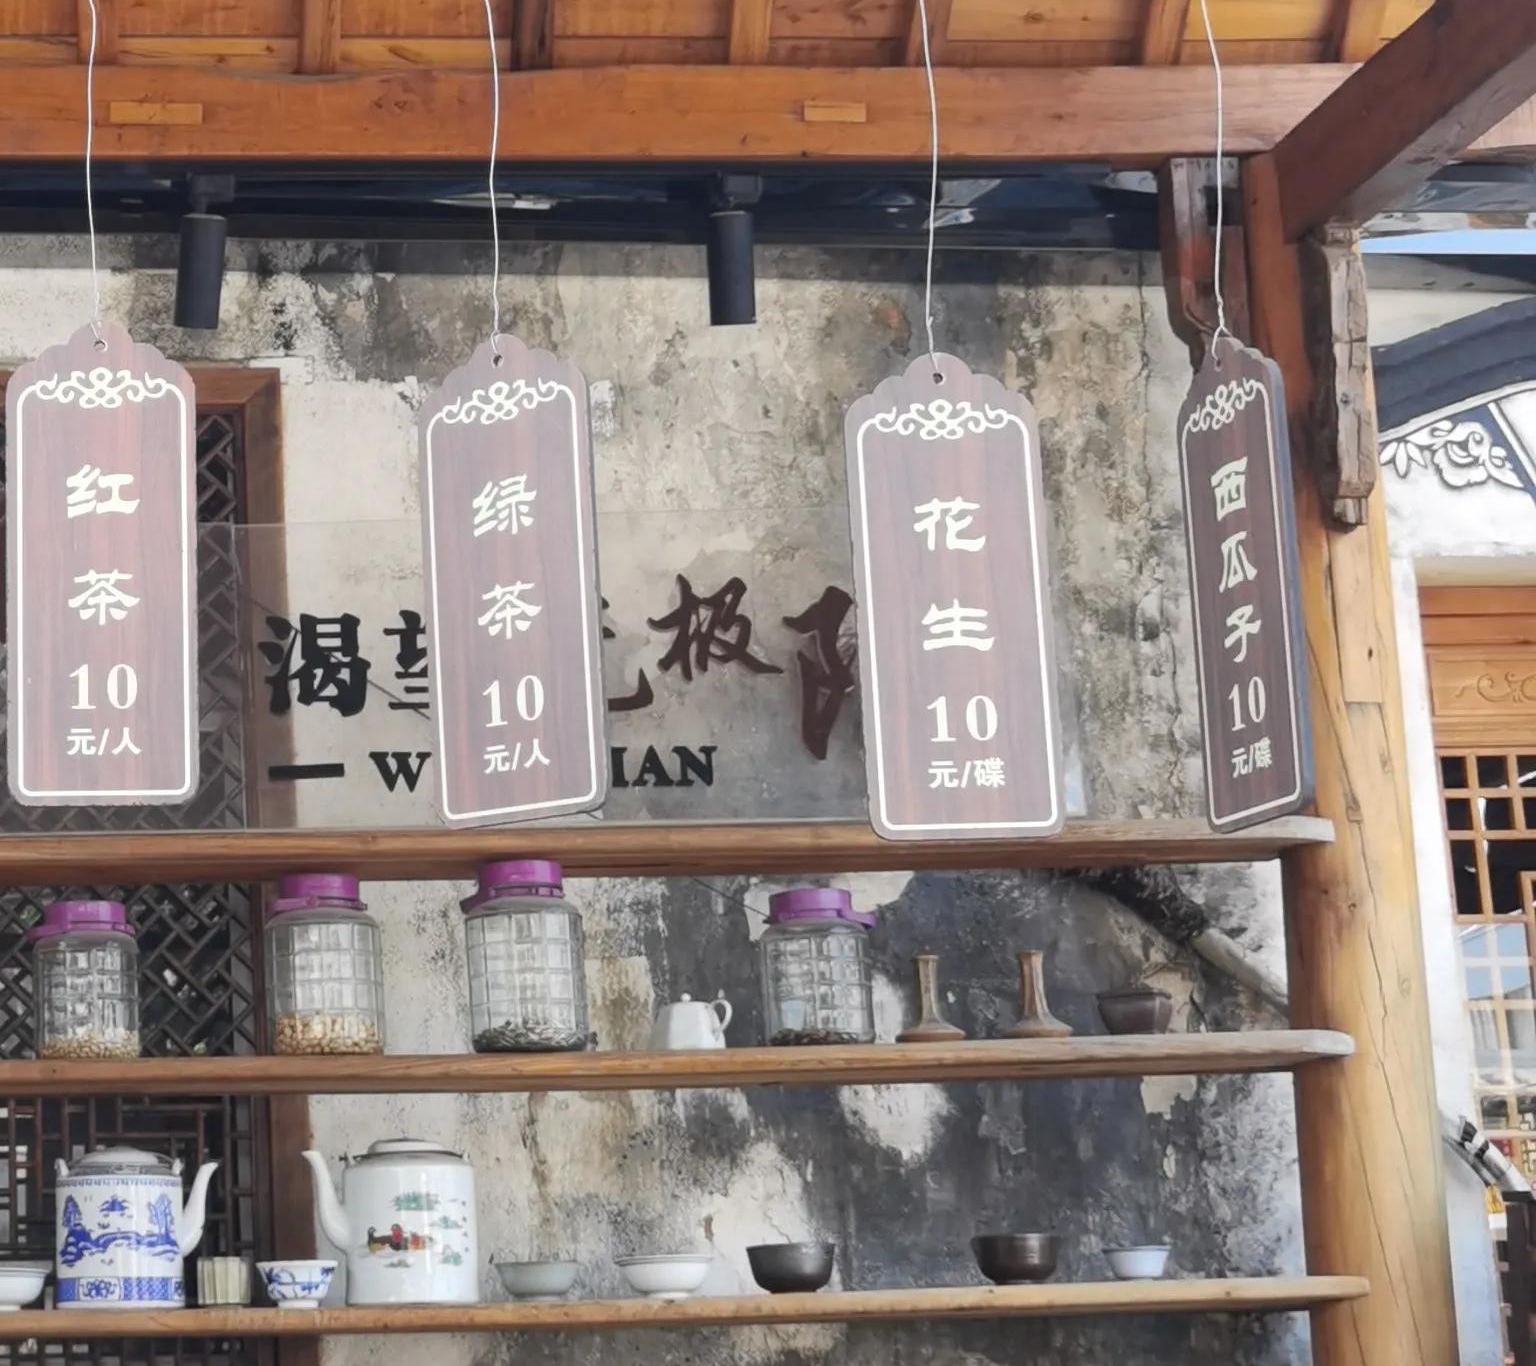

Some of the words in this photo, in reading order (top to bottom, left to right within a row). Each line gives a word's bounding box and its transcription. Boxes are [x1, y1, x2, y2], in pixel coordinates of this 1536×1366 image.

[66, 464, 141, 626] 红茶
[472, 474, 542, 640] 绿茶
[1210, 455, 1263, 664] 西瓜子
[913, 495, 995, 652] 花生
[68, 663, 140, 711] 10
[481, 673, 546, 729] 10
[1227, 675, 1267, 733] 10
[66, 728, 142, 757] 元/人
[925, 694, 1000, 743] 10
[482, 738, 551, 775] 元/人
[611, 745, 718, 789] IAN
[927, 756, 1006, 790] 元/碟
[1231, 736, 1273, 779] 元/碟
